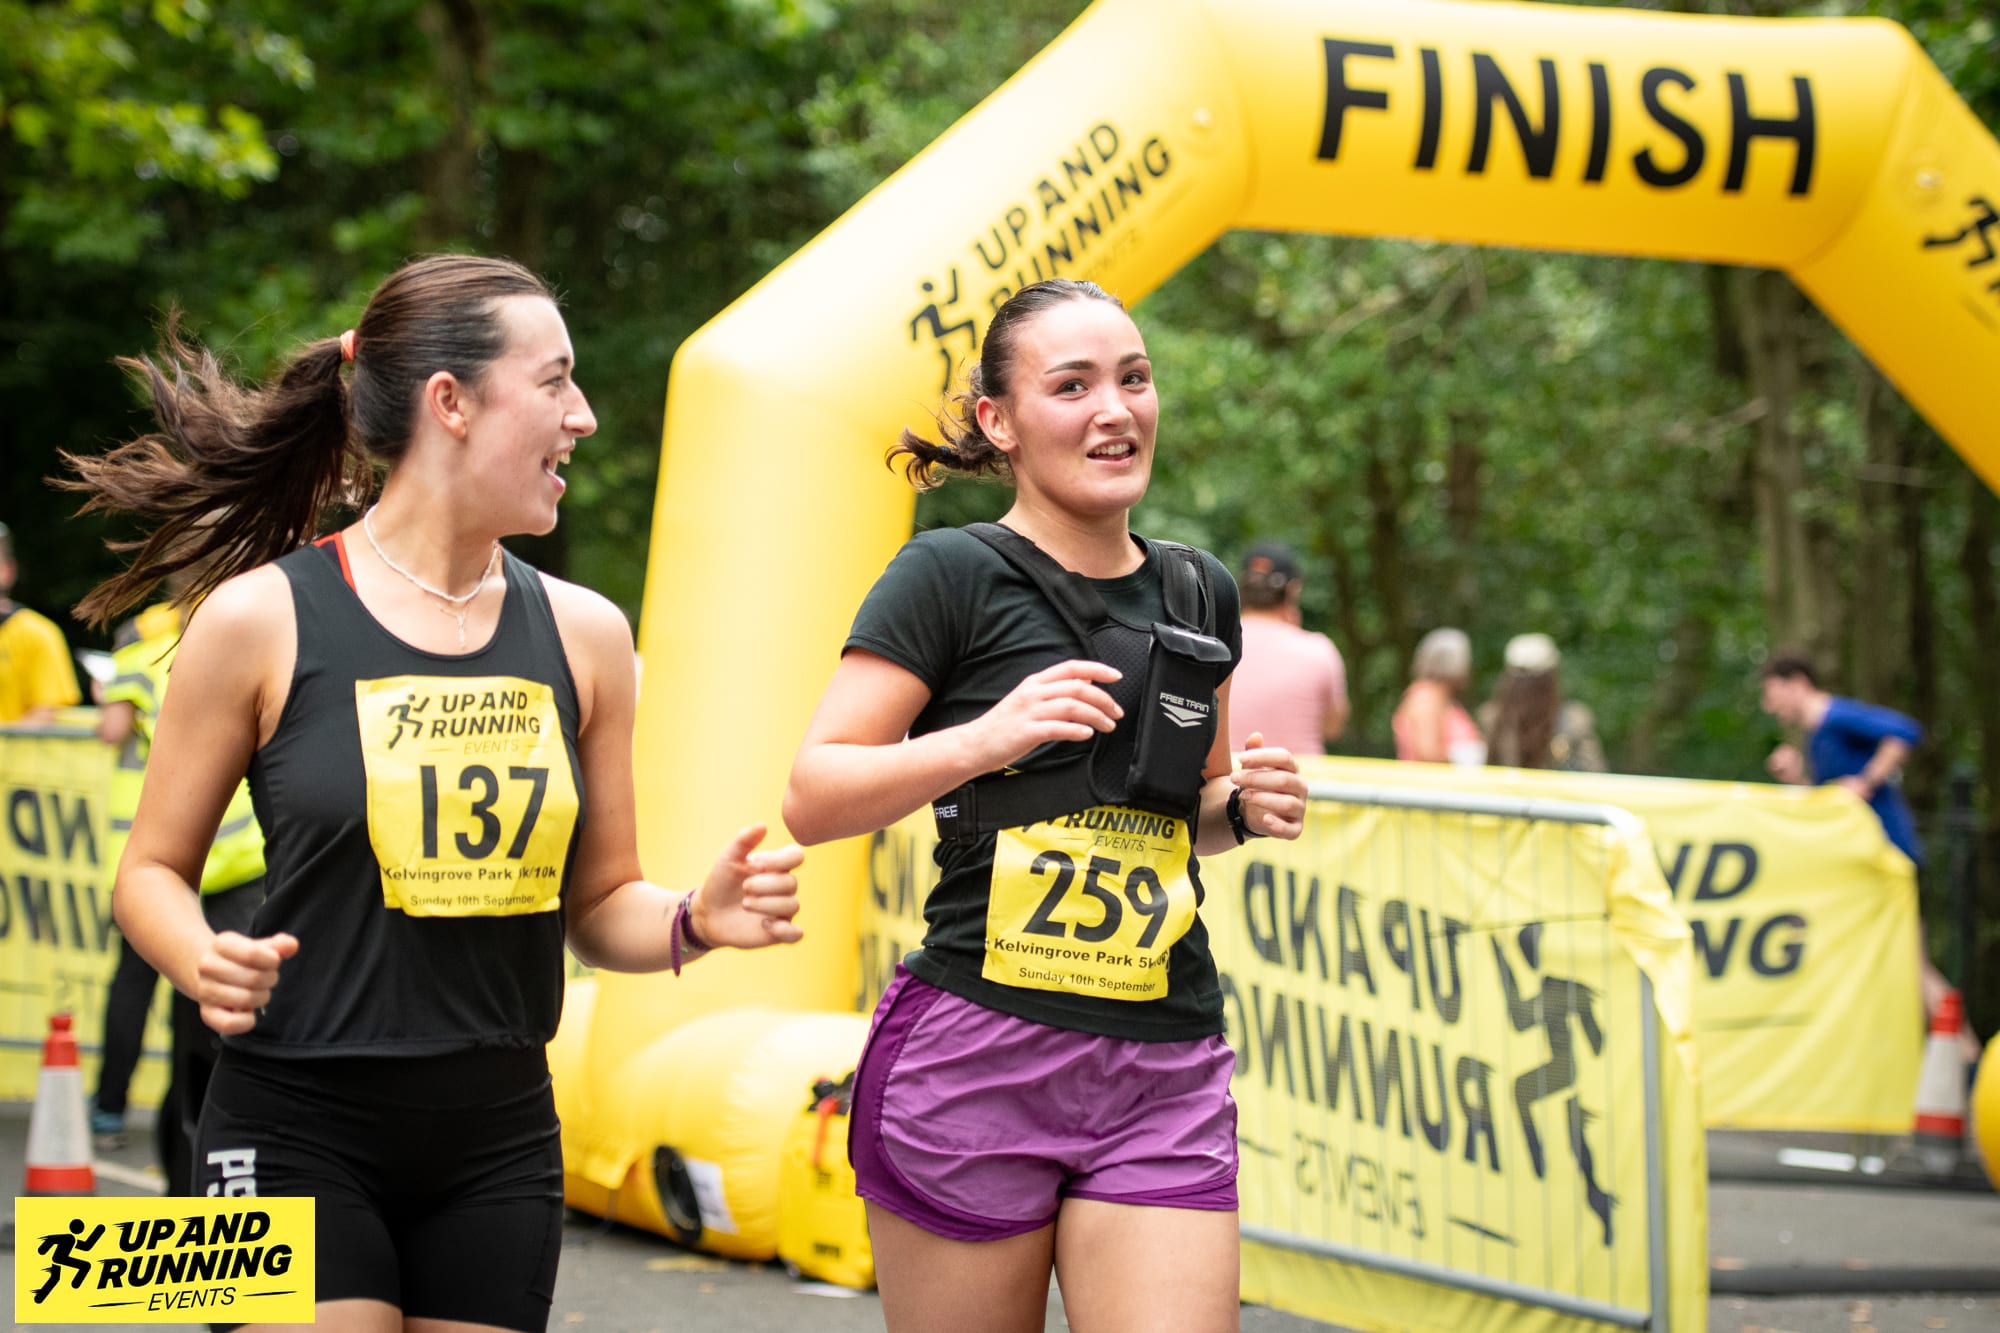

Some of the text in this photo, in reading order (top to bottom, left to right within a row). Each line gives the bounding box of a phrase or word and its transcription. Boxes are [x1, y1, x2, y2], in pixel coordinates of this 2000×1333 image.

[1314, 37, 1818, 198] FINISH
[974, 205, 1029, 270] UP
[1033, 123, 1120, 220] AND
[440, 690, 529, 713] UP AND
[1159, 692, 1210, 713] FREE TRAIN
[430, 714, 541, 739] RUNNING
[463, 738, 520, 755] EVENTS
[419, 764, 549, 860] 137
[934, 804, 959, 819] FREE
[1064, 810, 1176, 840] RUNNING
[1094, 835, 1147, 852] EVENTS
[383, 867, 473, 884] Kelvingrove
[478, 867, 513, 881] Park
[410, 894, 535, 909] Sunday 10th September
[1022, 850, 1170, 949] 259
[994, 938, 1090, 962] Kelvingrove
[1096, 951, 1133, 968] Park
[1018, 967, 1156, 993] Sunday 10th September
